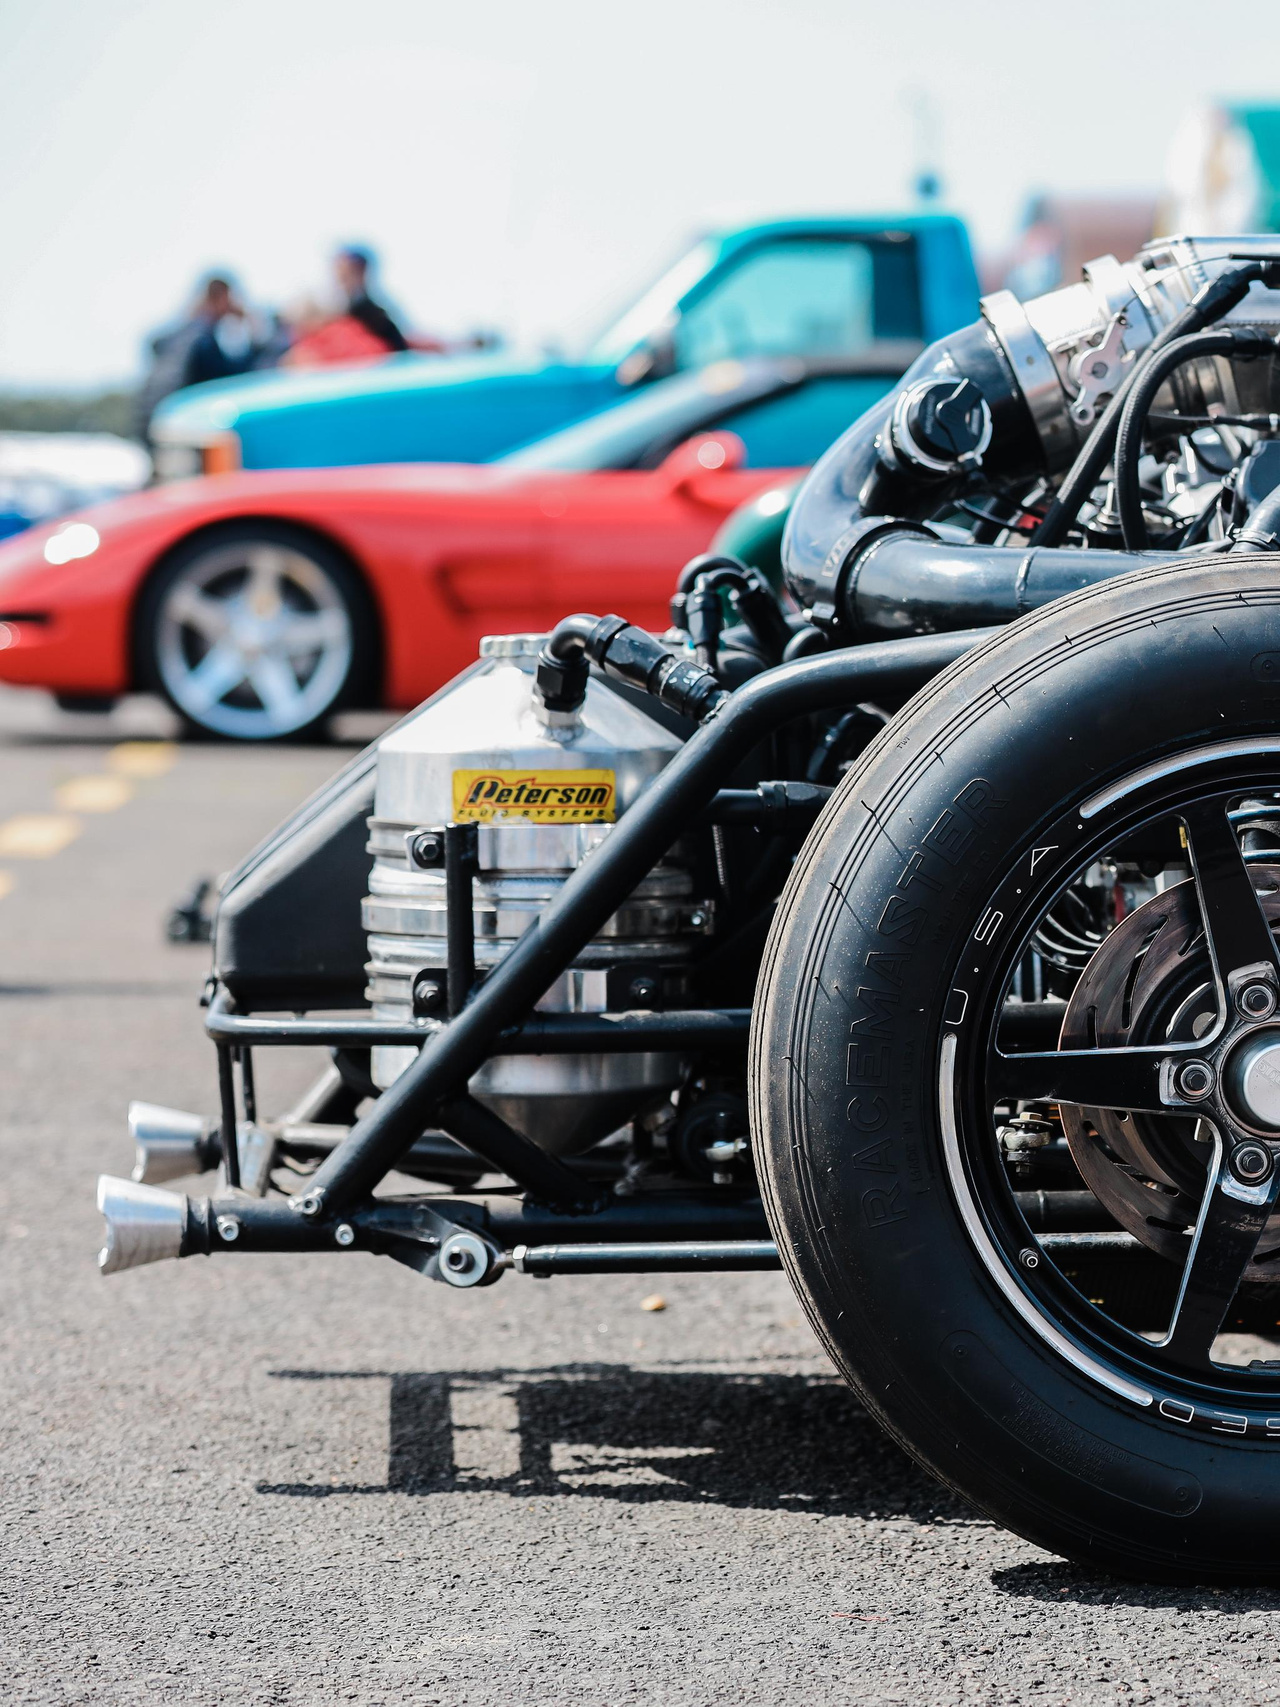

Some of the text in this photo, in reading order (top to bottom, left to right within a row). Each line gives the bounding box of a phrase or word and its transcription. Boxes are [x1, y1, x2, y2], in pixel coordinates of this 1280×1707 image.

[466, 780, 609, 805] Peterson
[521, 809, 606, 818] SYSTEMS
[845, 776, 1011, 1229] RACEMASTER
